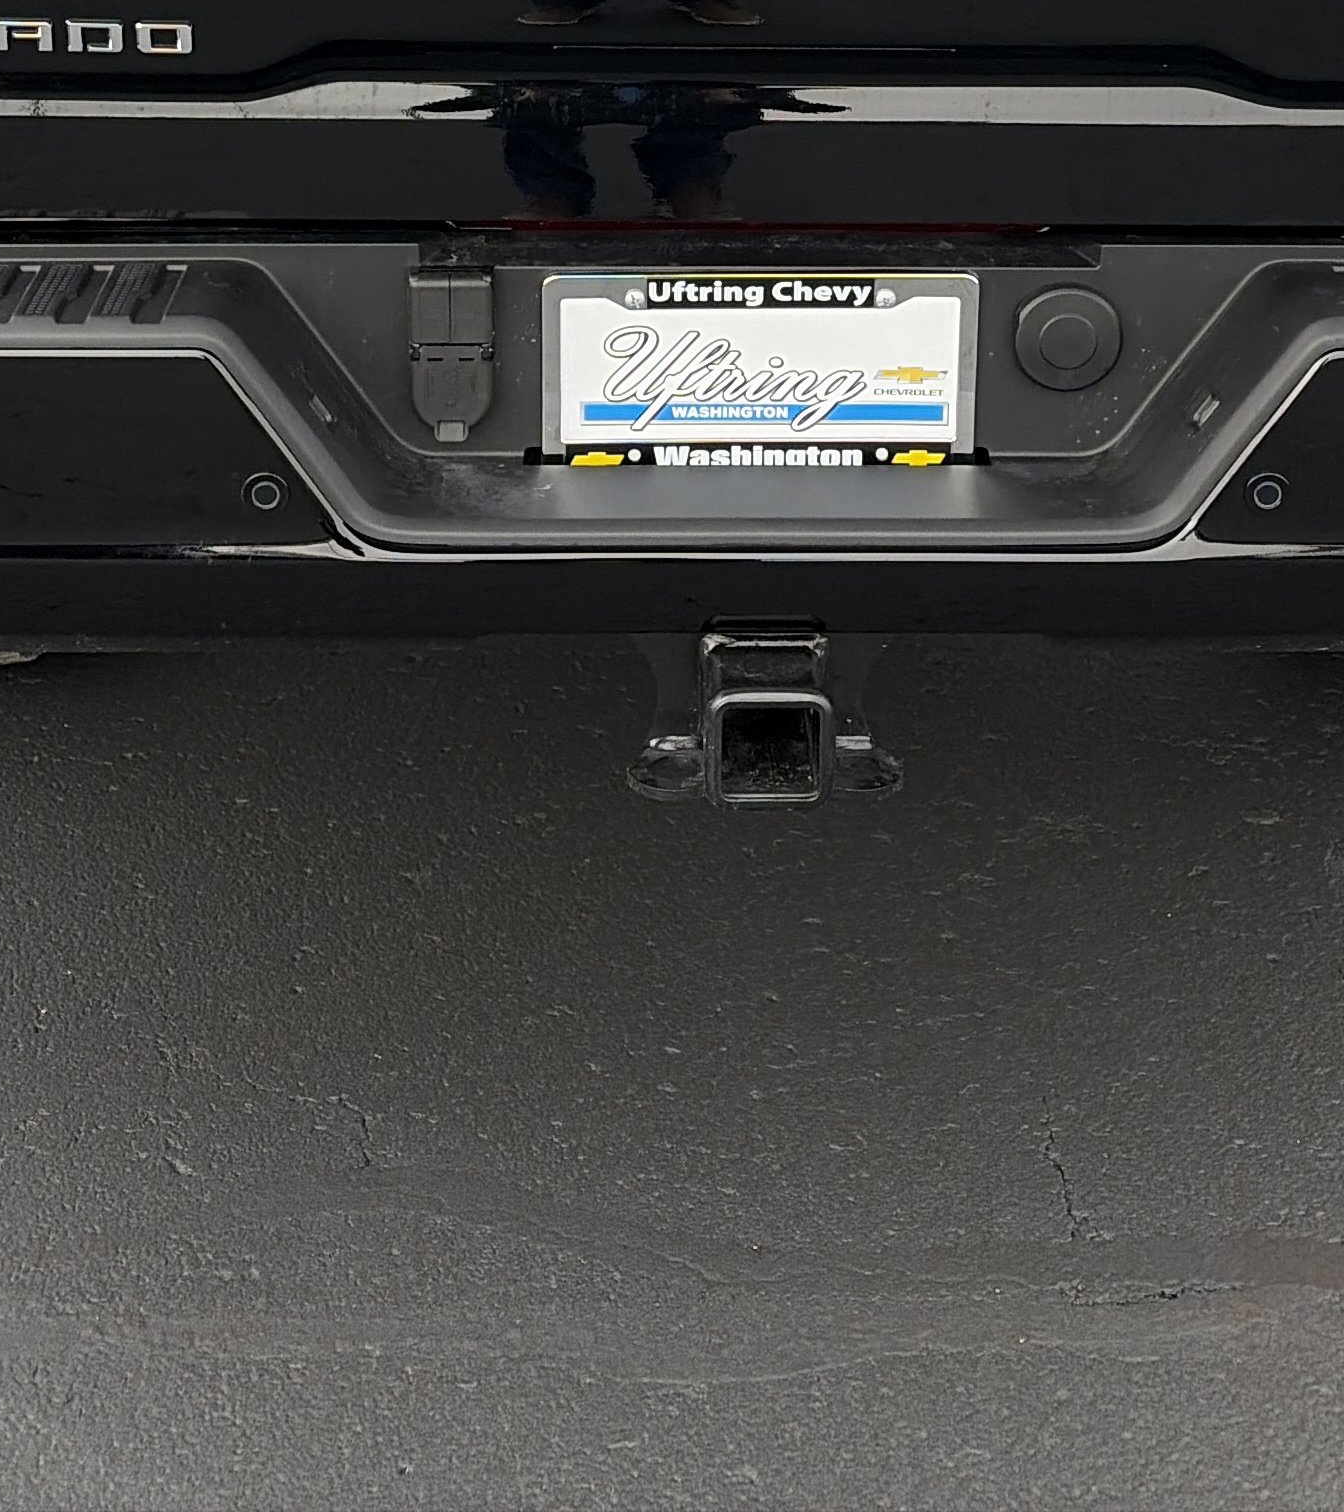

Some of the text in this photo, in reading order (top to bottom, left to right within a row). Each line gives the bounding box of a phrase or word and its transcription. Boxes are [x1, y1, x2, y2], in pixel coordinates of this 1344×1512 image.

[648, 280, 873, 307] Uftring Chevy
[603, 325, 867, 432] Uftring
[873, 388, 945, 398] CHEVROLET
[671, 405, 789, 419] WASHINGTON
[654, 445, 863, 467] Washington
